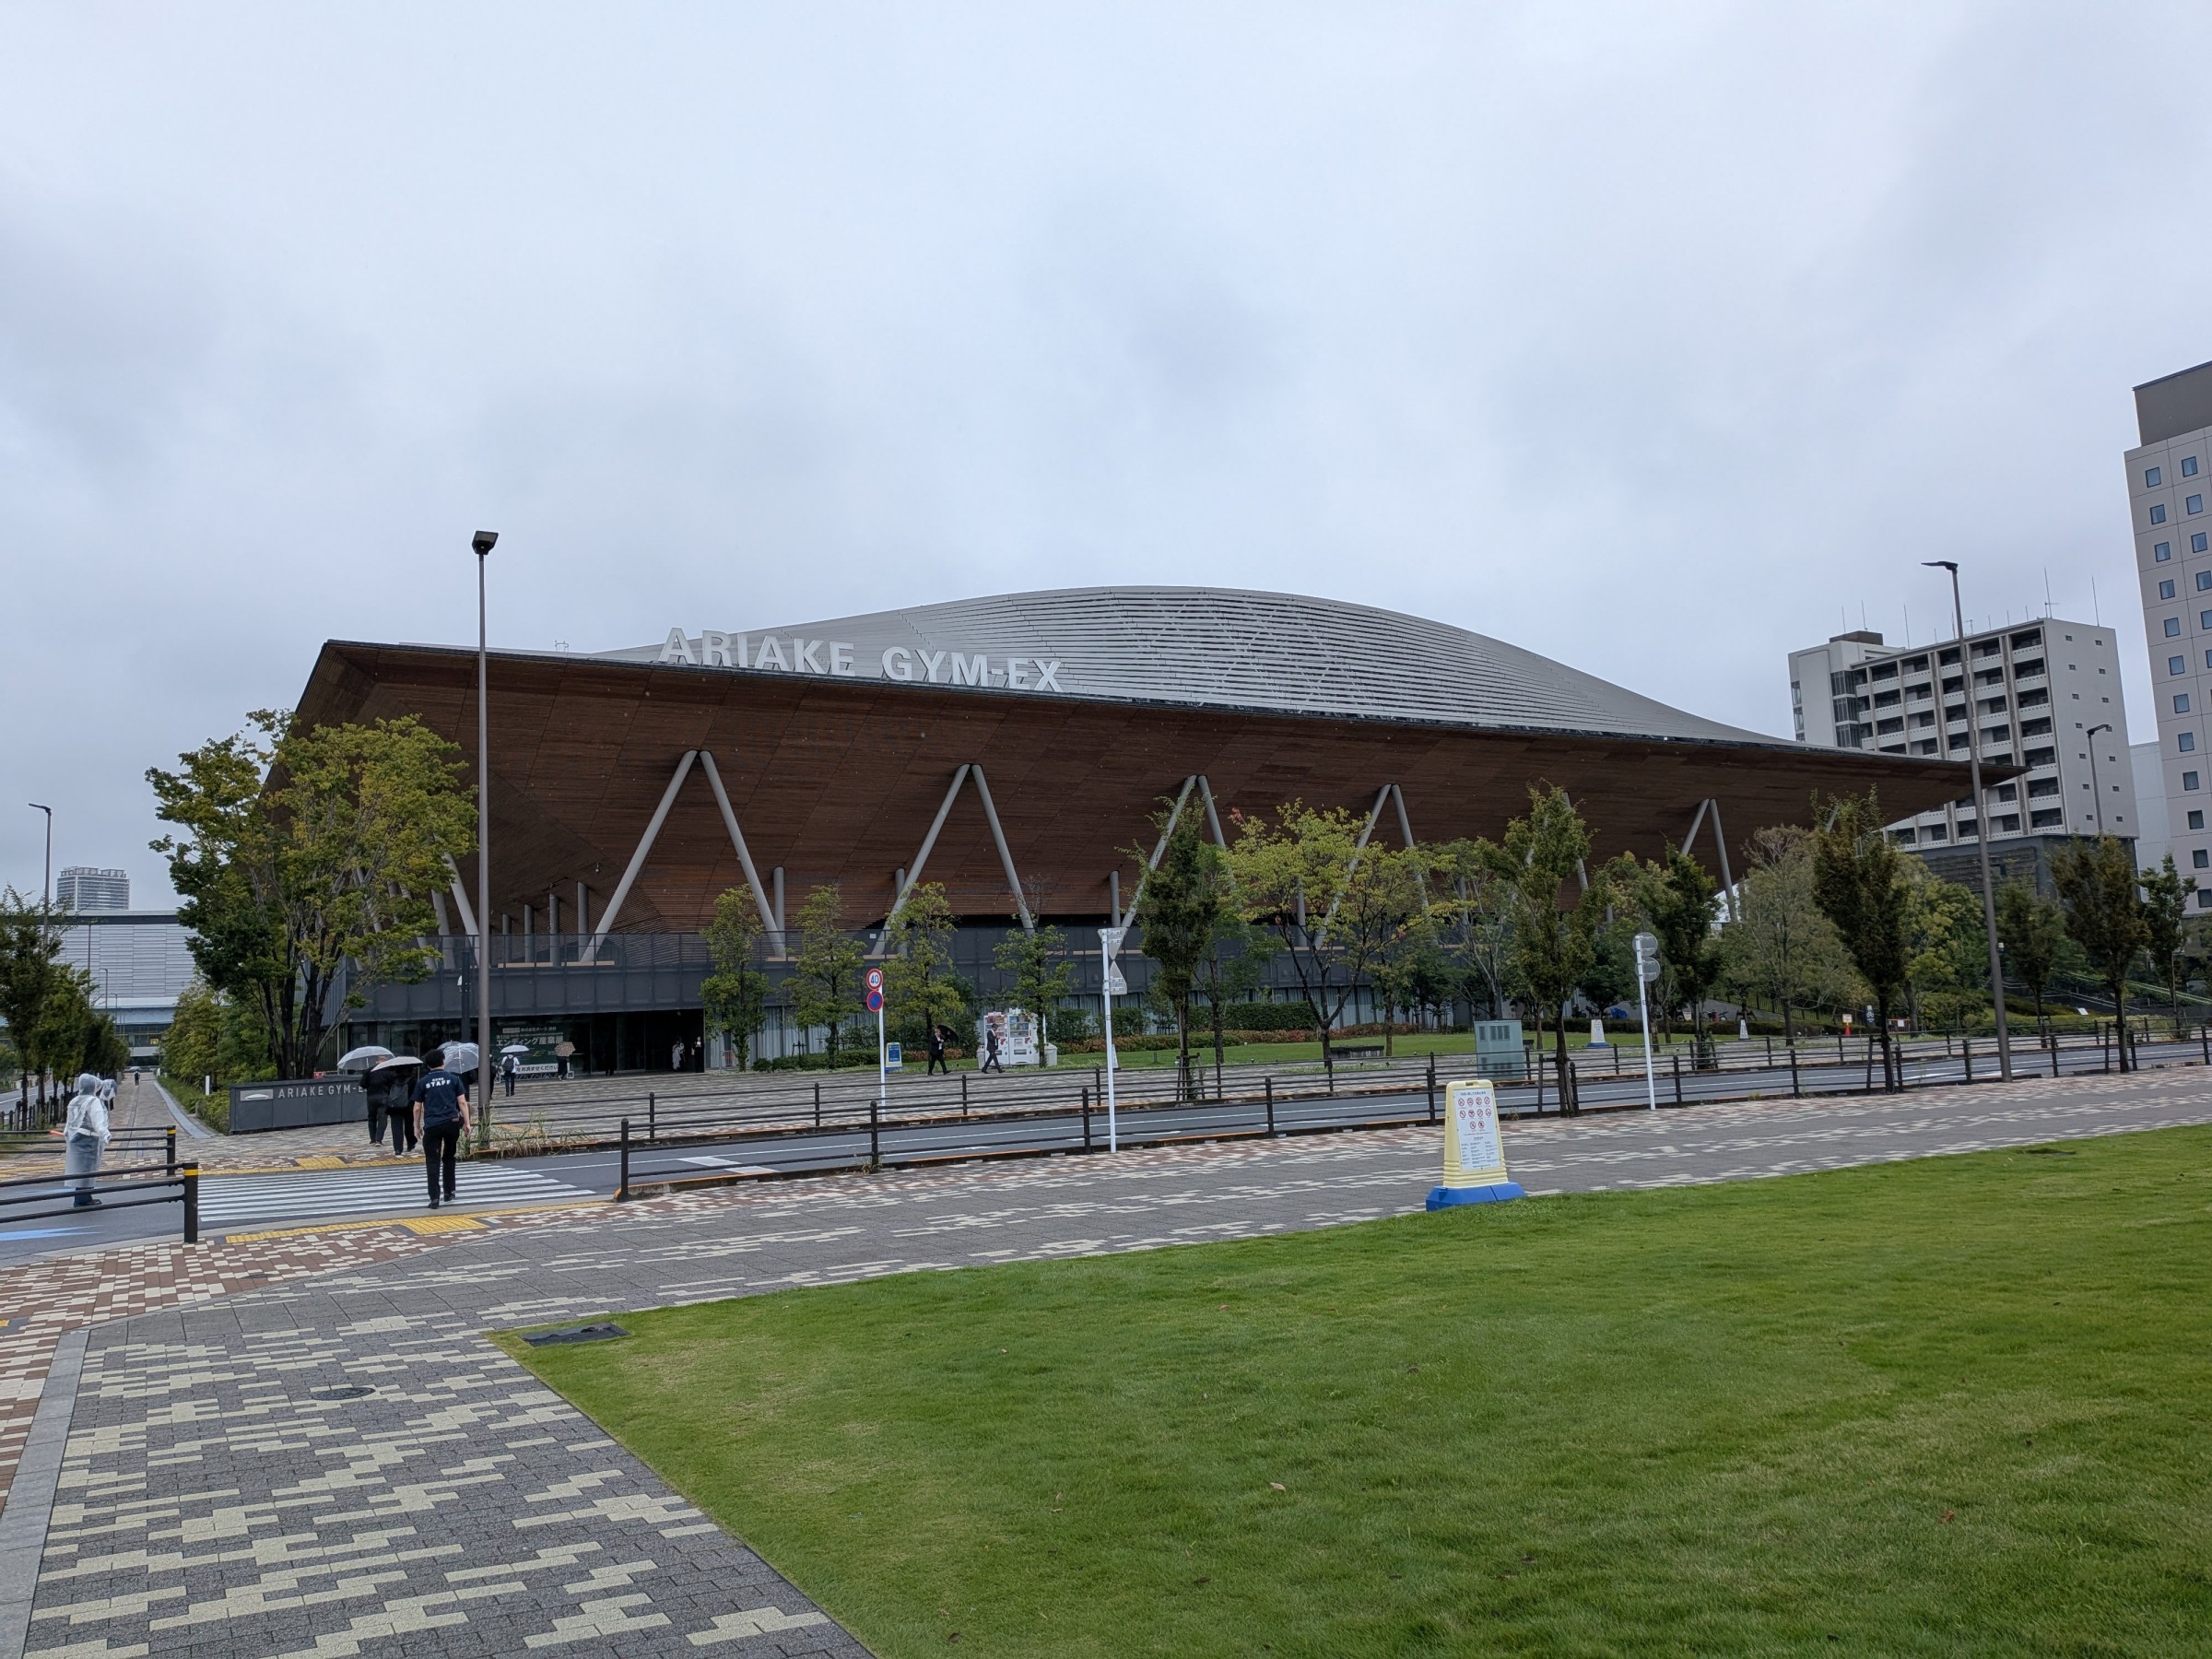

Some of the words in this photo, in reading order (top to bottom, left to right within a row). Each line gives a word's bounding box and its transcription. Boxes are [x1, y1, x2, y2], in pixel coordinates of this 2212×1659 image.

[657, 627, 856, 677] ARIAKE
[881, 646, 1064, 692] GYM-EX
[870, 974, 879, 984] 40
[426, 1079, 451, 1088] STAFF
[277, 1086, 324, 1099] ARIAKE
[328, 1084, 368, 1095] GYM-E
